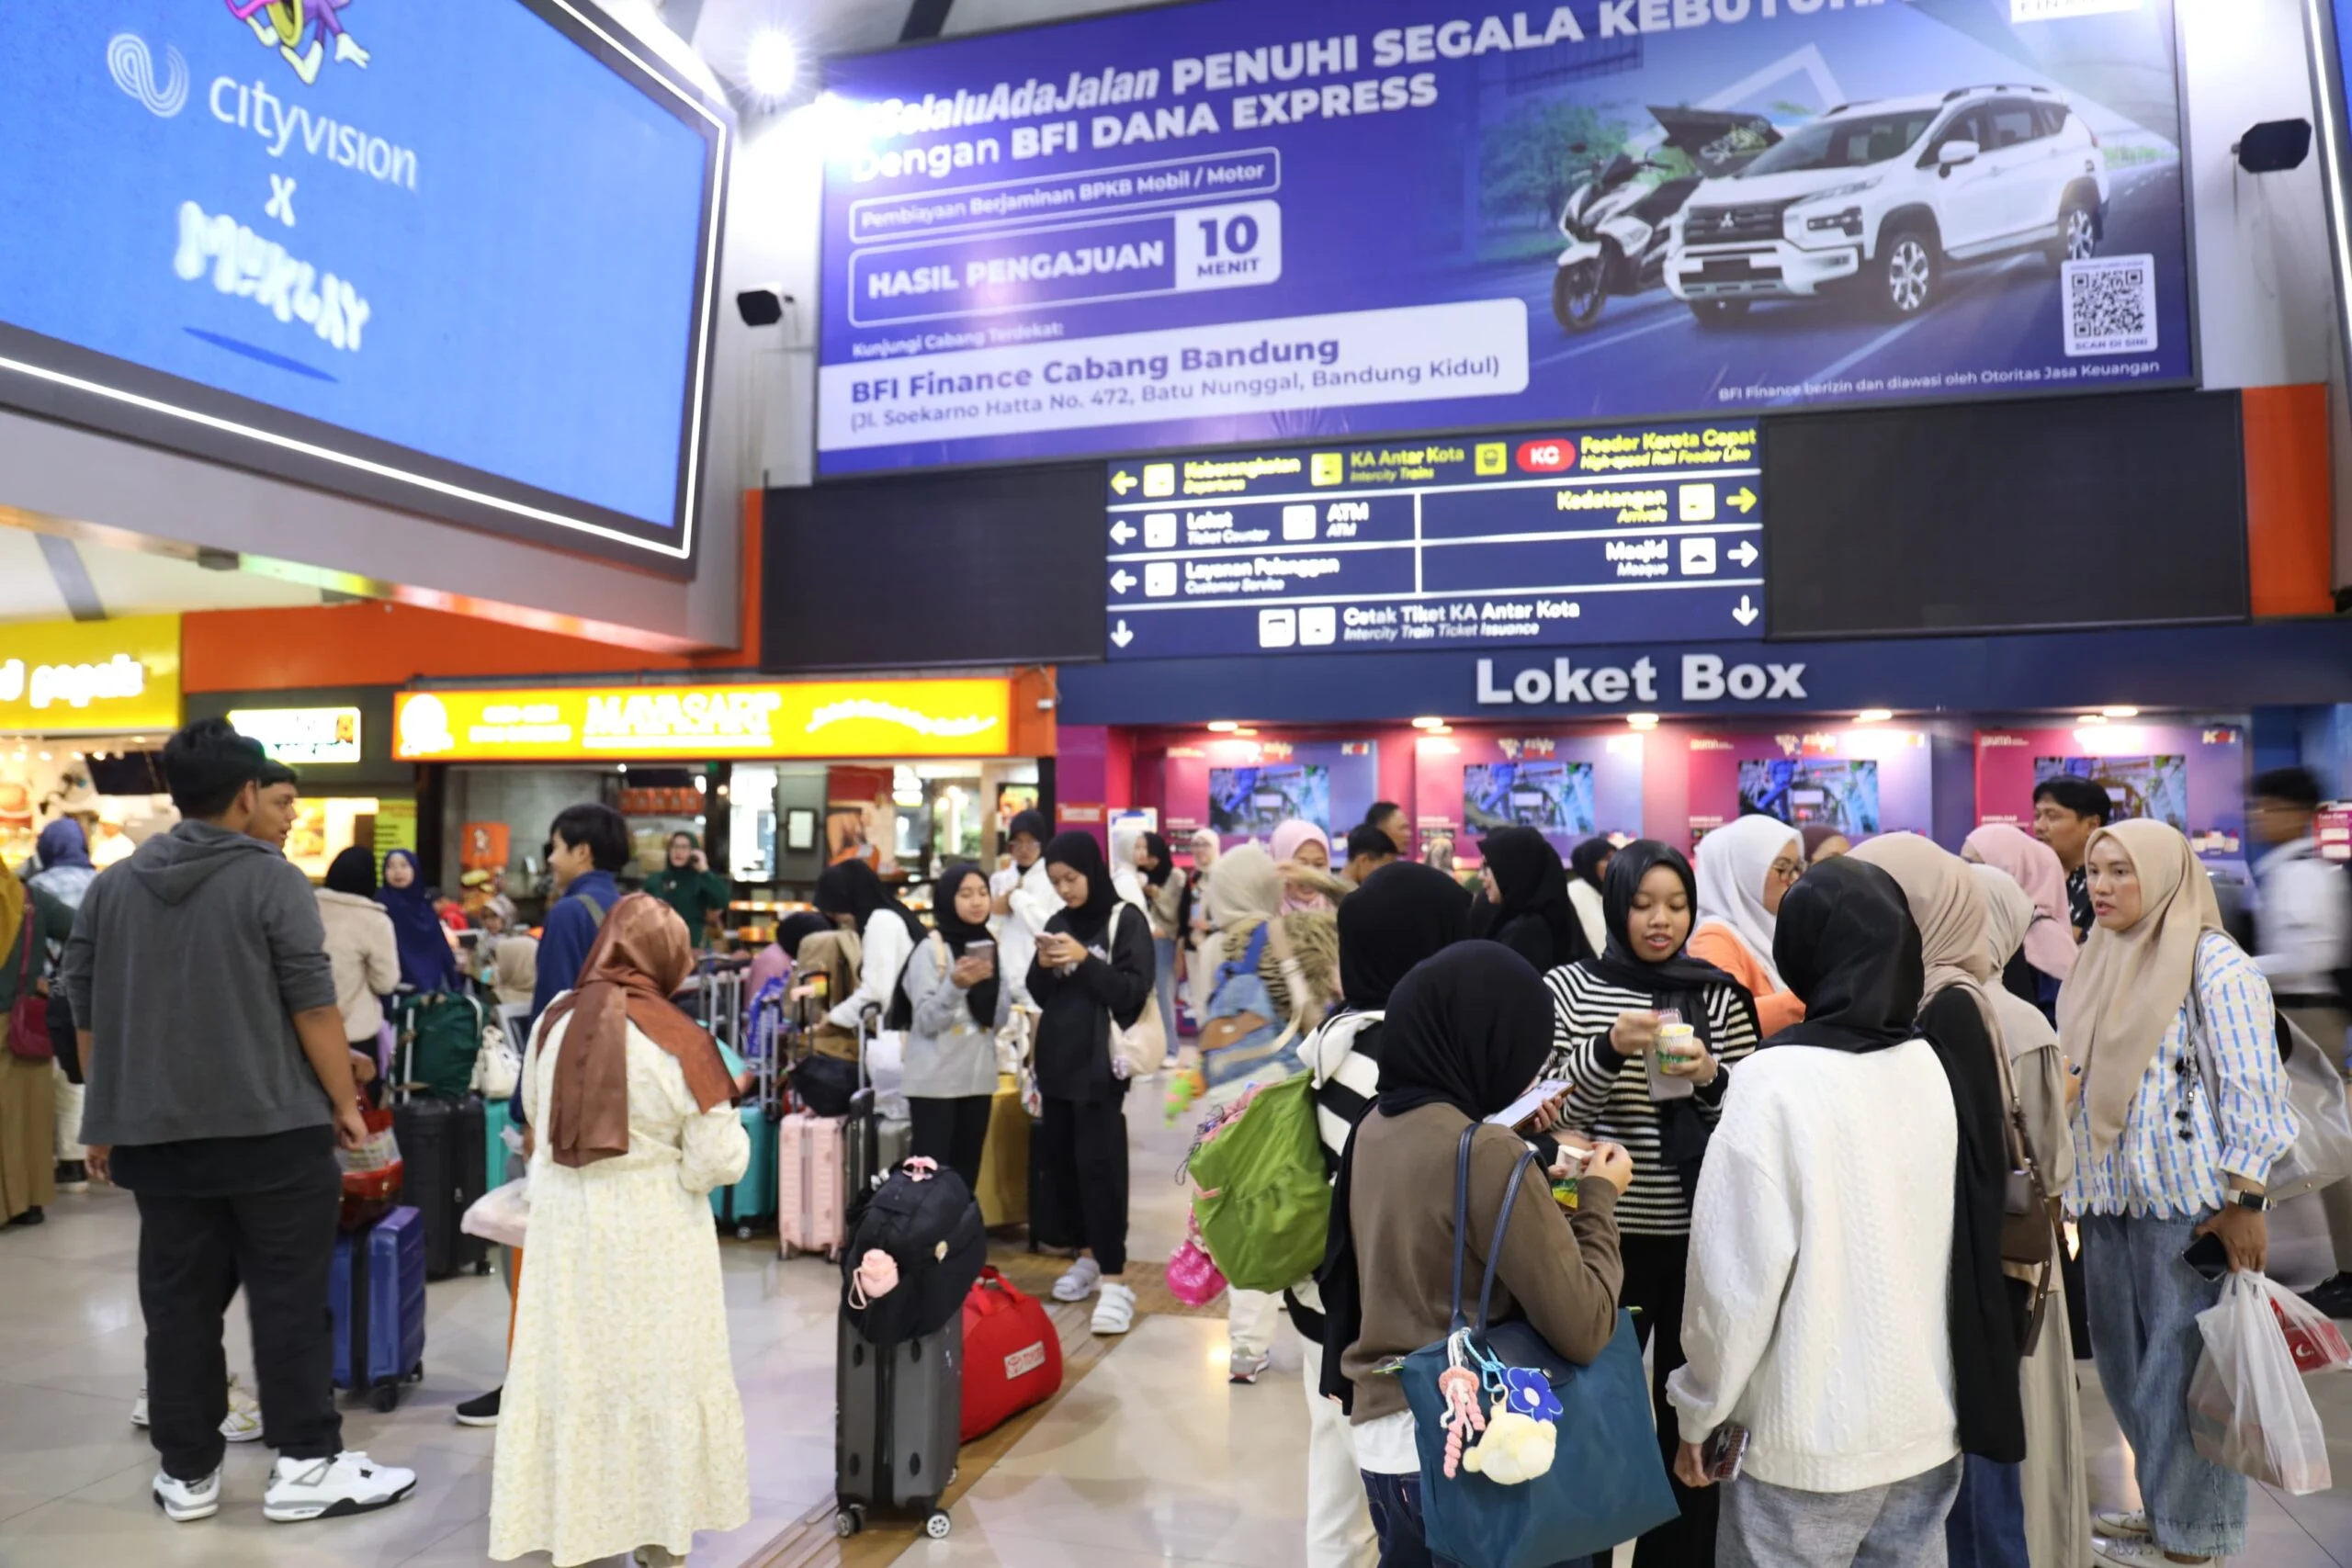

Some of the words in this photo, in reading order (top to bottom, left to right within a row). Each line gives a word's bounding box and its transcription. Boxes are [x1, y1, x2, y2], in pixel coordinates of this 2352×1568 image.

[1172, 34, 1358, 96] PENUHI
[1373, 6, 1584, 67] SEGALA
[852, 137, 1000, 183] Dengan
[1011, 119, 1079, 161] BFI
[1092, 102, 1220, 149] DANA
[1232, 73, 1439, 130] EXPRESS
[861, 201, 967, 230] Pembiayaan
[970, 186, 1074, 217] Berjaminan
[1080, 179, 1133, 200] BPKB
[1136, 170, 1190, 196] Mobil
[1206, 164, 1265, 186] Motor
[1198, 214, 1259, 258] 10
[868, 265, 959, 299] HASIL
[967, 240, 1164, 288] PENGAJUAN
[1197, 258, 1261, 278] MENIT
[853, 336, 922, 358] Kunjungi
[924, 329, 986, 351] Cabang
[852, 378, 899, 404] BFI
[910, 366, 1032, 399] Finance
[1043, 355, 1169, 385] Cabang
[1181, 338, 1340, 369] Bandung
[884, 403, 978, 426] Soekarno
[986, 396, 1042, 416] Hatta
[1050, 392, 1083, 411] No.
[1091, 389, 1135, 407] 472,
[1142, 379, 1193, 401] Batu
[1201, 371, 1305, 396] Nunggal,
[1312, 362, 1421, 388] Bandung
[1430, 355, 1500, 378] Kidul)
[1718, 387, 1742, 401] BFI
[1746, 384, 1801, 399] Finance
[1804, 379, 1852, 395] berizin
[1856, 378, 1883, 391] dan
[1888, 372, 1941, 389] diawasi
[1945, 371, 1977, 385] oleh
[1981, 368, 2041, 383] Otoritas
[2044, 366, 2077, 380] Jasa
[2081, 361, 2160, 378] Keuangan
[1351, 451, 1375, 468] KA
[1379, 448, 1425, 466] Antar
[1426, 446, 1464, 463] Kota
[1580, 434, 1639, 454] Feeder
[1327, 502, 1369, 523] ATM
[1343, 606, 1397, 626] Cetak
[1400, 604, 1446, 624] Tiket
[1450, 603, 1478, 621] KA
[1481, 601, 1534, 621] Antar
[1536, 600, 1580, 619] Kota
[1343, 626, 1398, 642] Intercity
[1401, 624, 1435, 639] Train
[1438, 623, 1478, 637] Ticket
[1480, 622, 1540, 637] Issuance
[1476, 655, 1658, 705] Loket
[1681, 653, 1808, 701] Box
